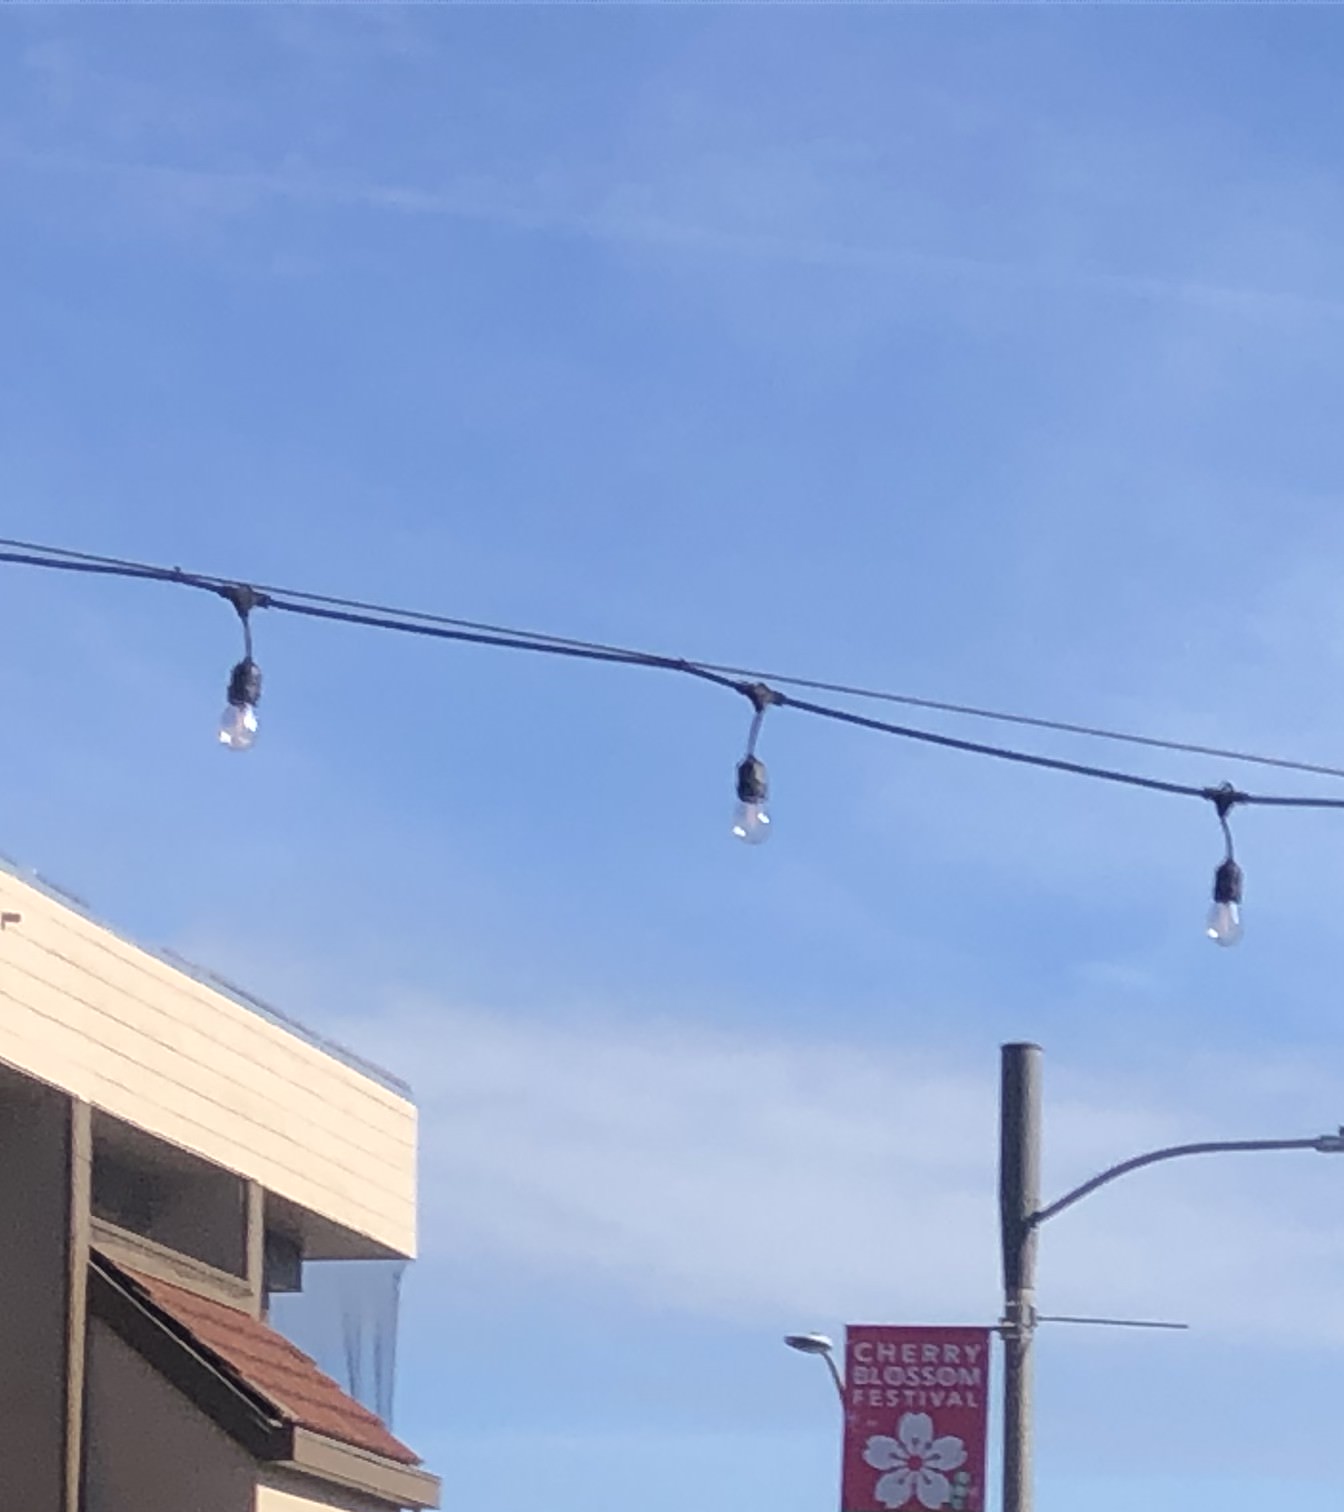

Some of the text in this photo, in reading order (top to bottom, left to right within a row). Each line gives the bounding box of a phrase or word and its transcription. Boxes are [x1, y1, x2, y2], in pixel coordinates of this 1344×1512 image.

[853, 1342, 981, 1363] CHERRY
[853, 1366, 981, 1387] BLOSSOM
[852, 1389, 979, 1408] FESTIVAL
